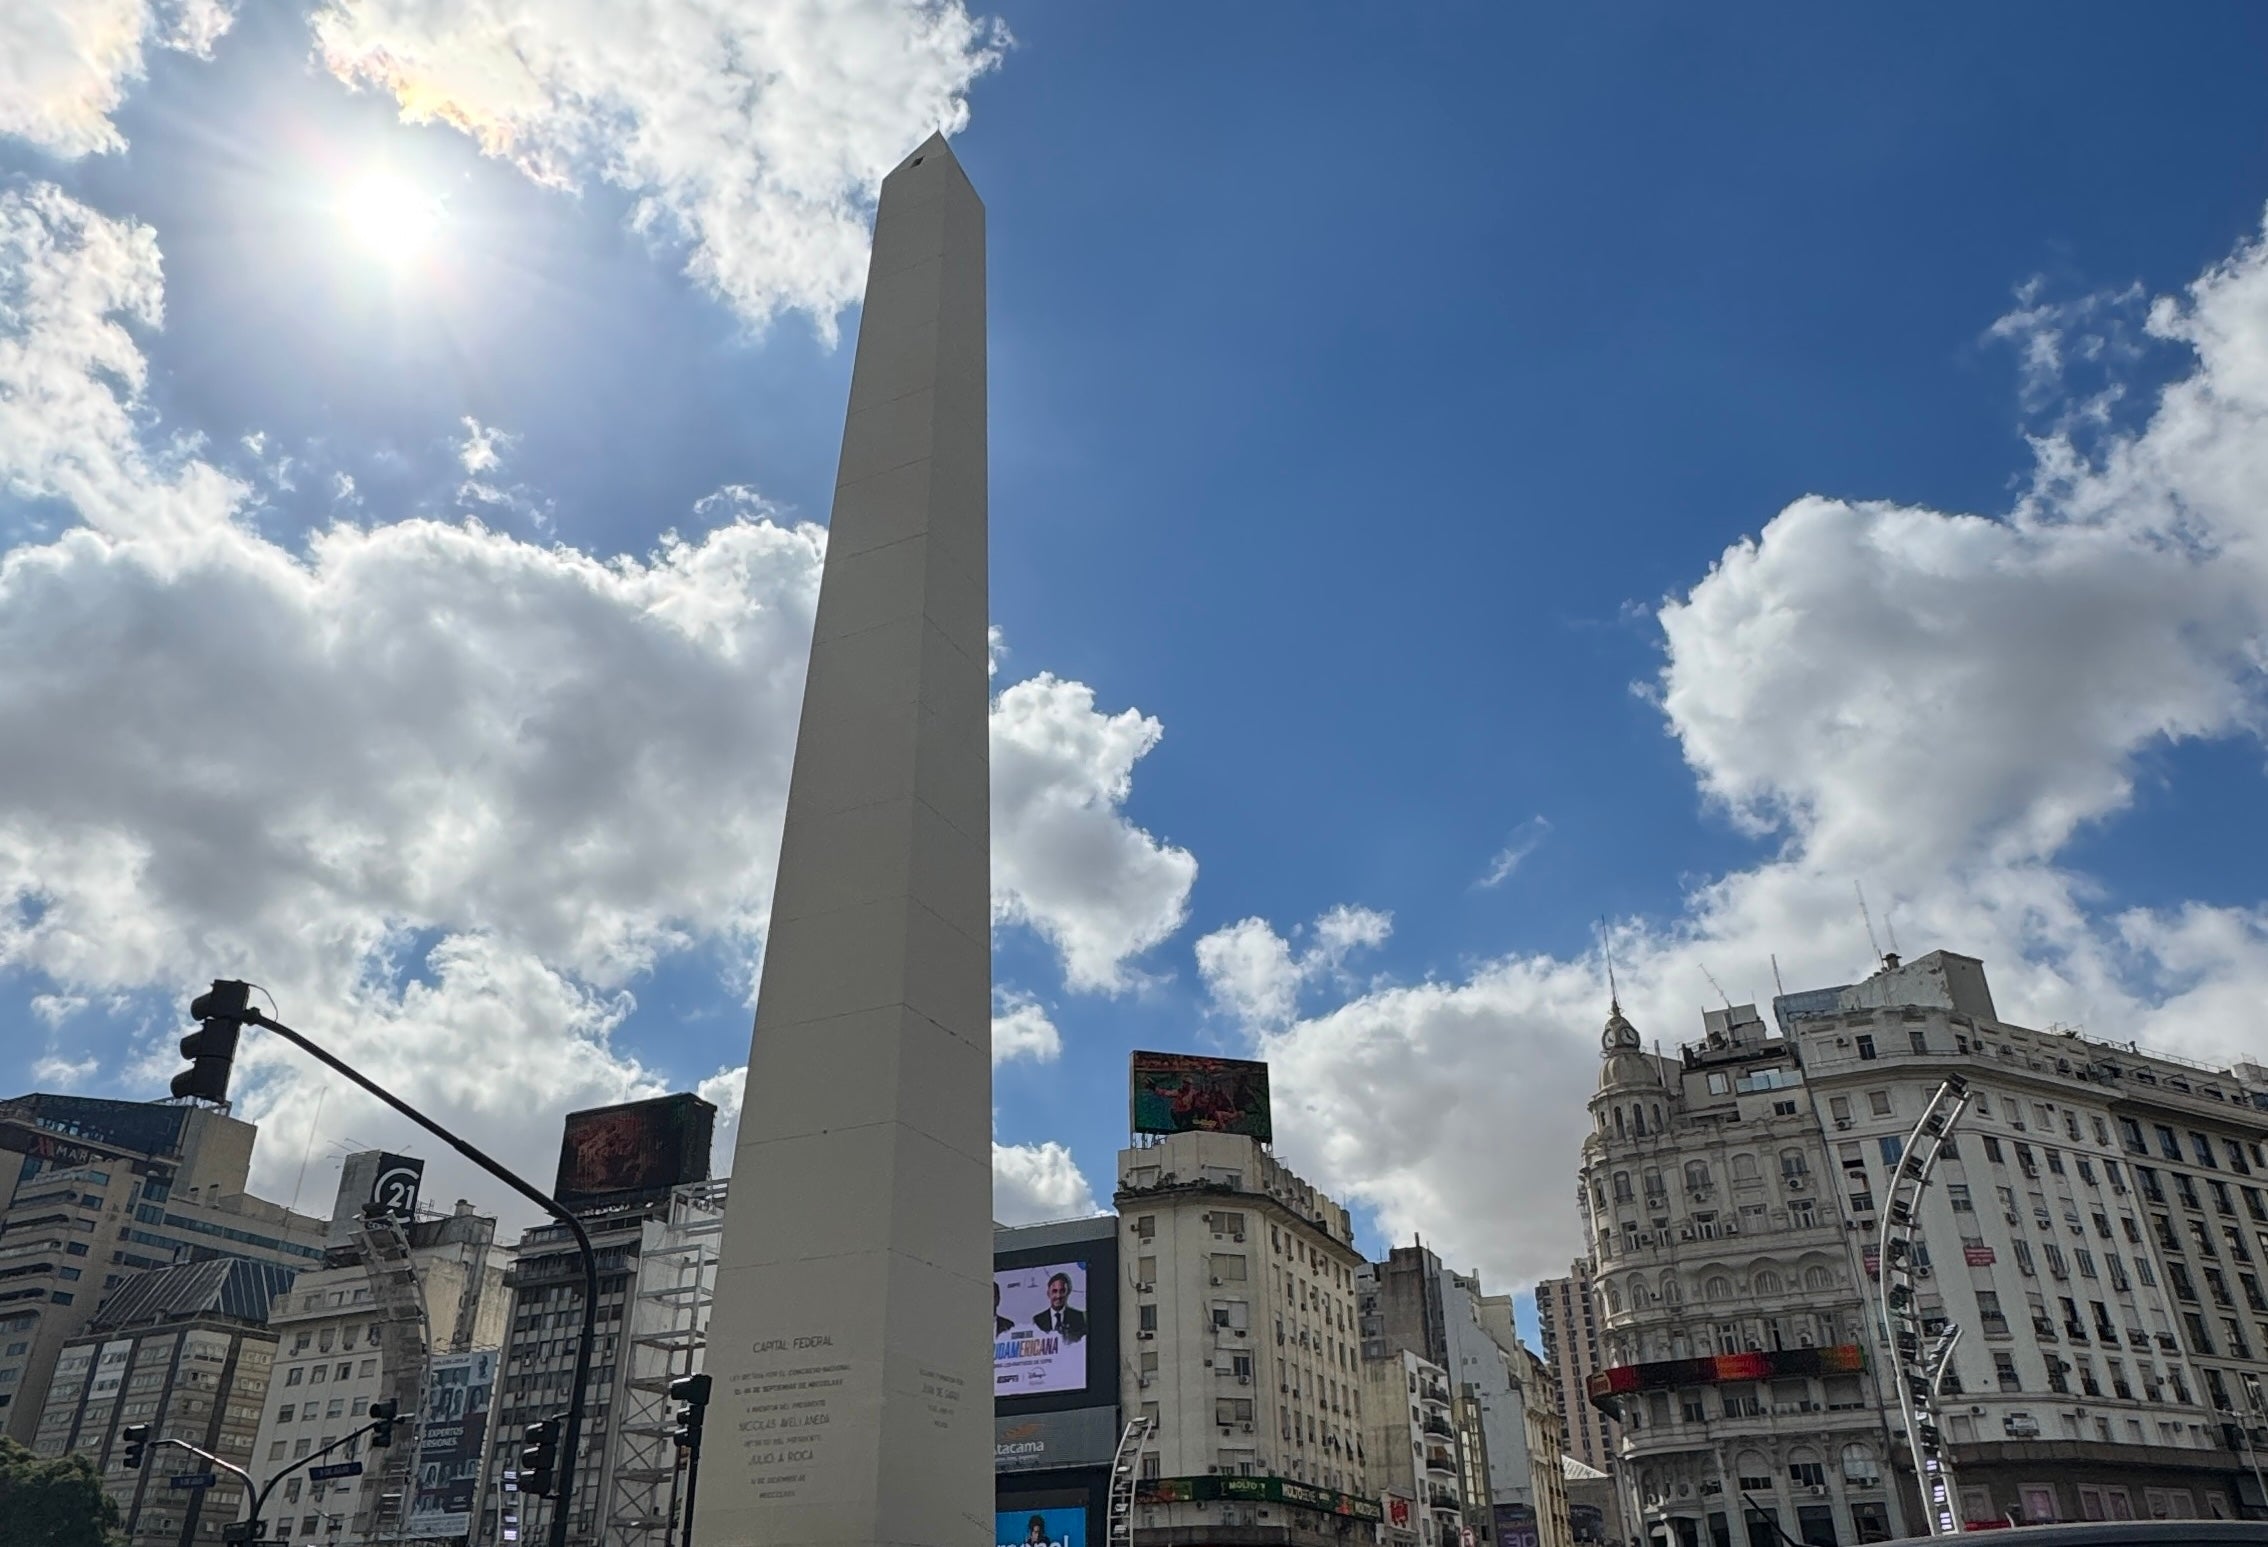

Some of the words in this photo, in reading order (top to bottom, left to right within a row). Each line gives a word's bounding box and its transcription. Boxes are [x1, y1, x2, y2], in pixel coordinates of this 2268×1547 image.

[753, 1340, 788, 1353] CAPITAL
[793, 1336, 833, 1349] FEDERAL
[420, 1437, 457, 1448] ERSIONES
[994, 1441, 1045, 1455] tacama
[1229, 1481, 1257, 1490] MOLTO
